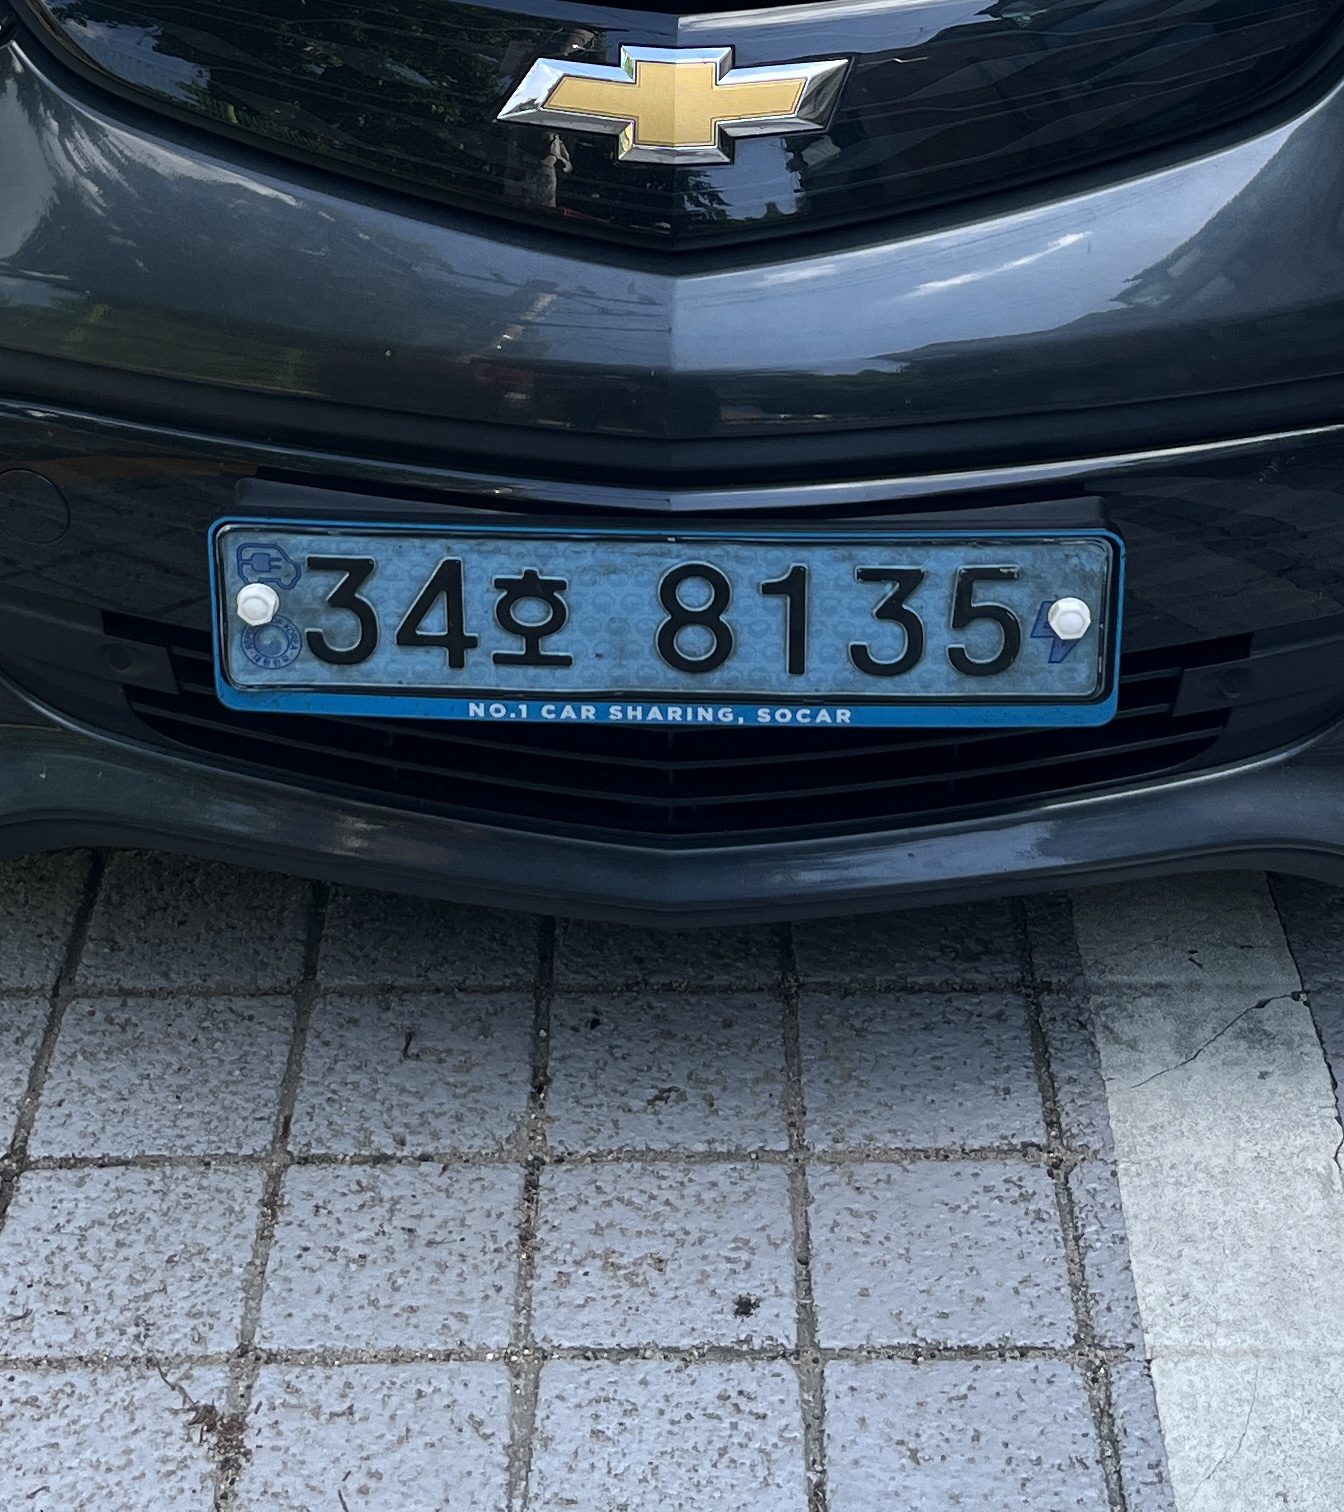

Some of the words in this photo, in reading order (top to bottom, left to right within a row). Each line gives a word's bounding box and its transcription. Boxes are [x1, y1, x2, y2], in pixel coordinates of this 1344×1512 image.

[305, 555, 573, 669] 34호
[655, 560, 1022, 676] 8135
[468, 702, 528, 718] NO.1
[541, 704, 596, 720] CAR
[608, 705, 744, 724] SHARING,
[757, 708, 851, 724] SOCAR
